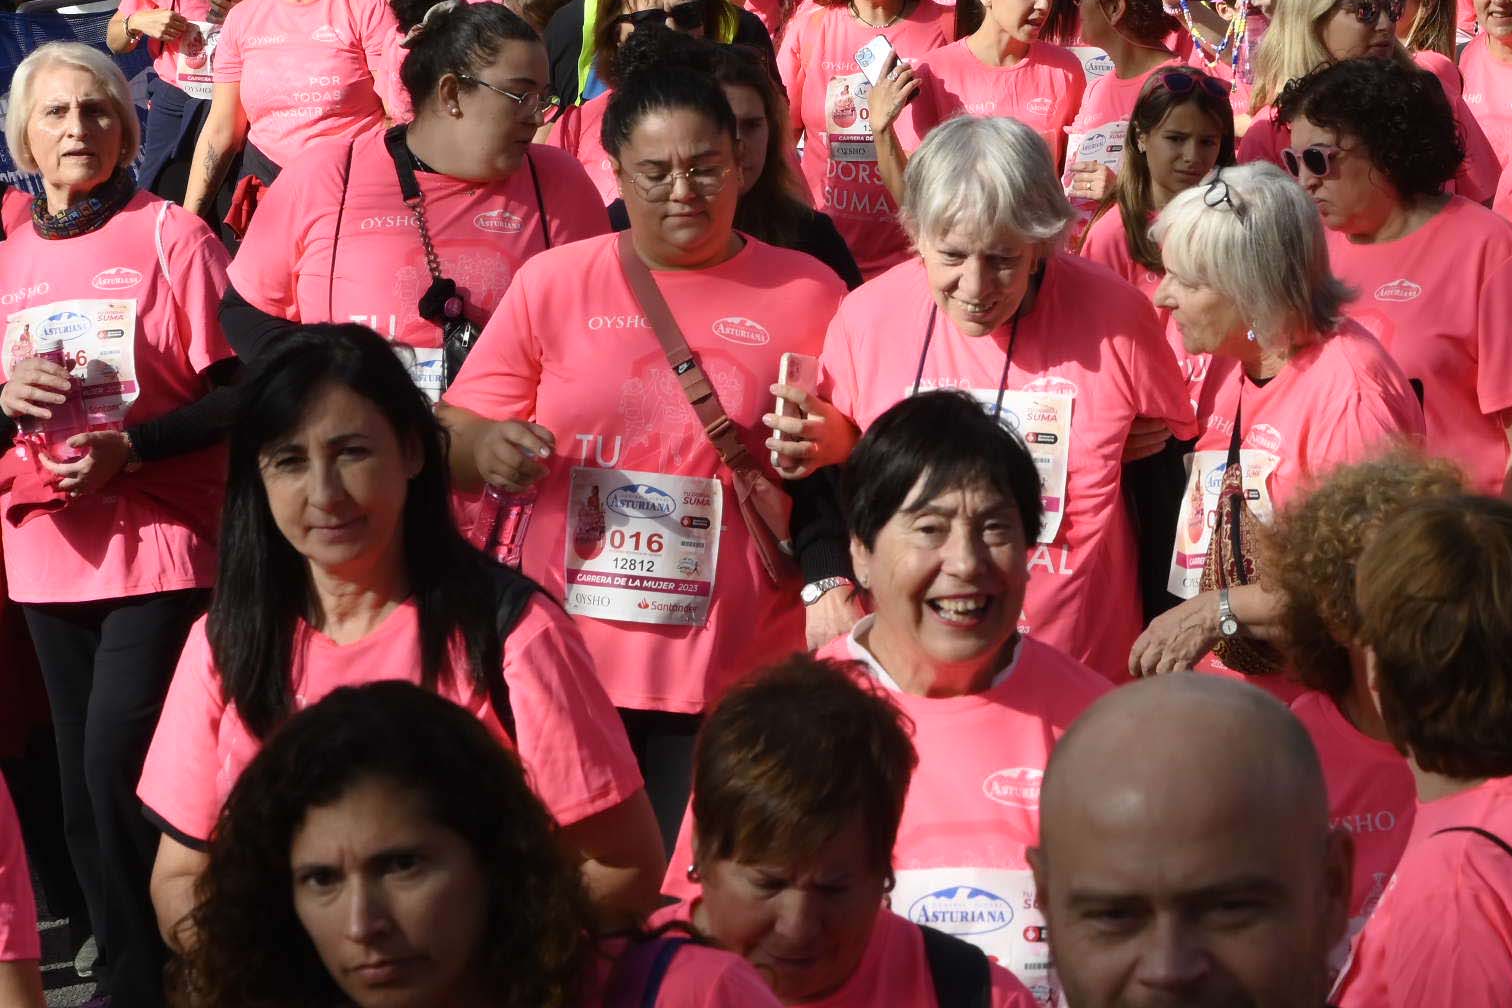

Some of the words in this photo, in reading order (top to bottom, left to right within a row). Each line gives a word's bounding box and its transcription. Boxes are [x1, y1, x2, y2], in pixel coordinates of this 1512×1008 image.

[309, 75, 341, 87] POR
[292, 91, 342, 103] TODAS
[825, 161, 885, 185] DORS
[823, 186, 890, 215] SUMA
[95, 273, 139, 286] ASTURIANA
[1, 282, 49, 305] OYSHO
[97, 313, 124, 322] SUMA
[42, 320, 88, 337] ASTURIANA
[716, 324, 766, 343] ASTURIANA
[1026, 413, 1058, 423] SUMA
[576, 434, 622, 468] TU
[610, 495, 671, 514] ASTURIANA
[681, 497, 712, 507] SUMA
[610, 529, 664, 553] 016
[612, 557, 656, 573] 12812
[576, 573, 613, 586] CARRERA
[614, 577, 626, 587] DE
[627, 579, 641, 588] LA
[642, 580, 675, 591] MUJER
[678, 583, 699, 592] 2023
[575, 592, 611, 607] OYSHO
[651, 600, 699, 614] Santander
[917, 904, 1007, 924] ASTURIANA
